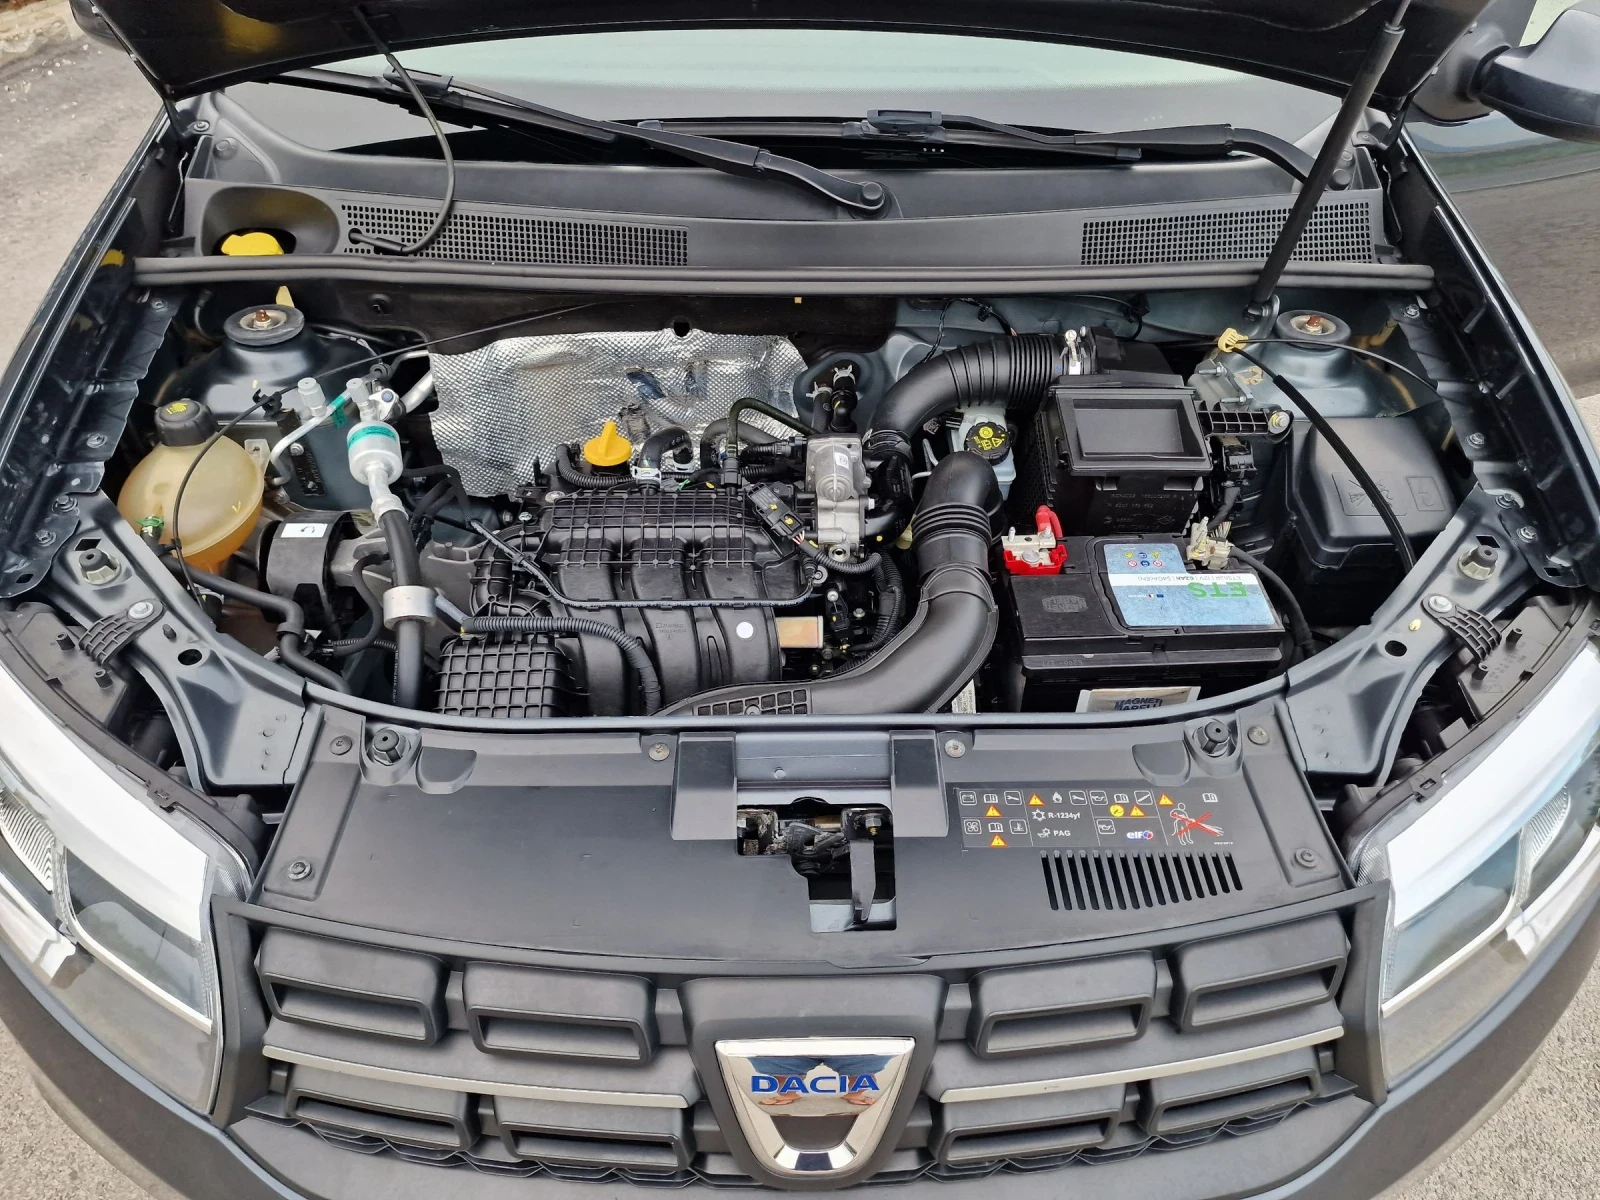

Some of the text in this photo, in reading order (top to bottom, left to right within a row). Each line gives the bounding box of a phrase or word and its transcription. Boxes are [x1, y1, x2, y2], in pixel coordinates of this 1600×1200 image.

[1189, 582, 1248, 598] ETS
[1048, 812, 1081, 820] R-1234yf
[1126, 831, 1143, 839] elf
[751, 1074, 879, 1094] DACIA
